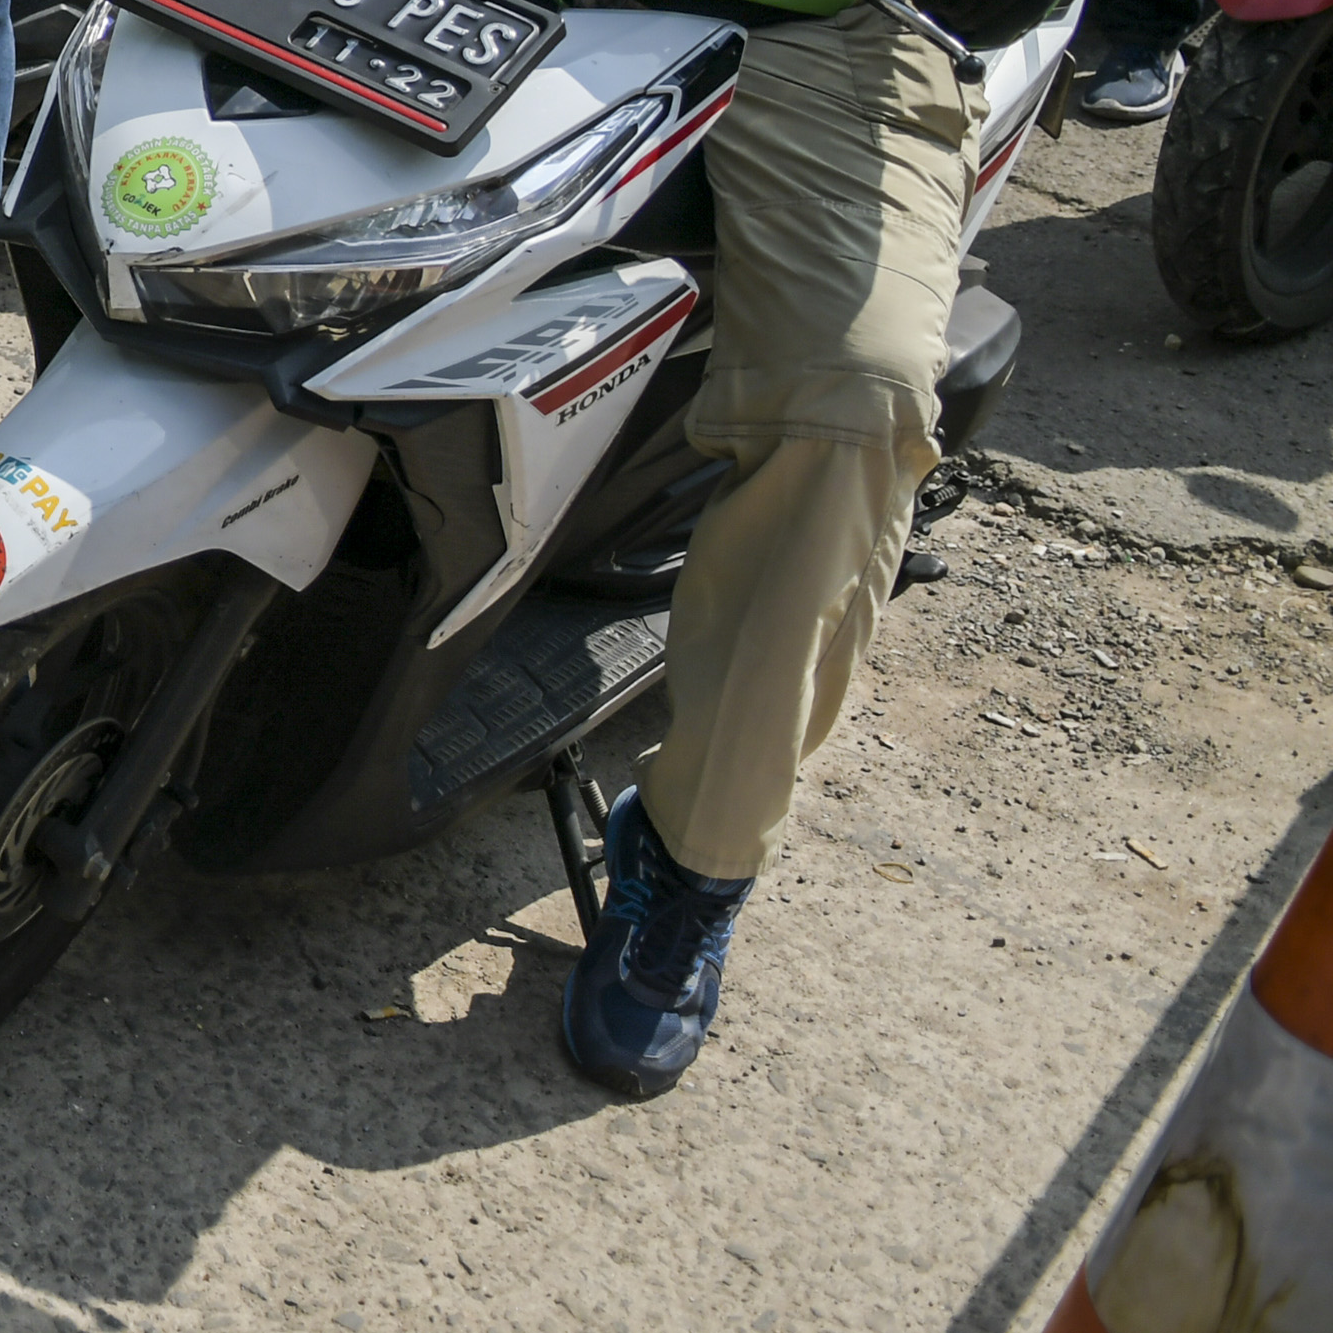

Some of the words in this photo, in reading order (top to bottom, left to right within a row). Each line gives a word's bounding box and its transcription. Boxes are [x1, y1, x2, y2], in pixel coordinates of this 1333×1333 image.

[126, 140, 162, 159] ADMIN
[166, 139, 213, 196] JABODETABEK
[122, 193, 136, 203] GO
[142, 201, 162, 217] JEK
[165, 211, 197, 232] BATAS
[556, 352, 652, 427] HONDA
[19, 475, 78, 532] PAY
[221, 494, 263, 529] Combi
[262, 474, 299, 504] Brake
